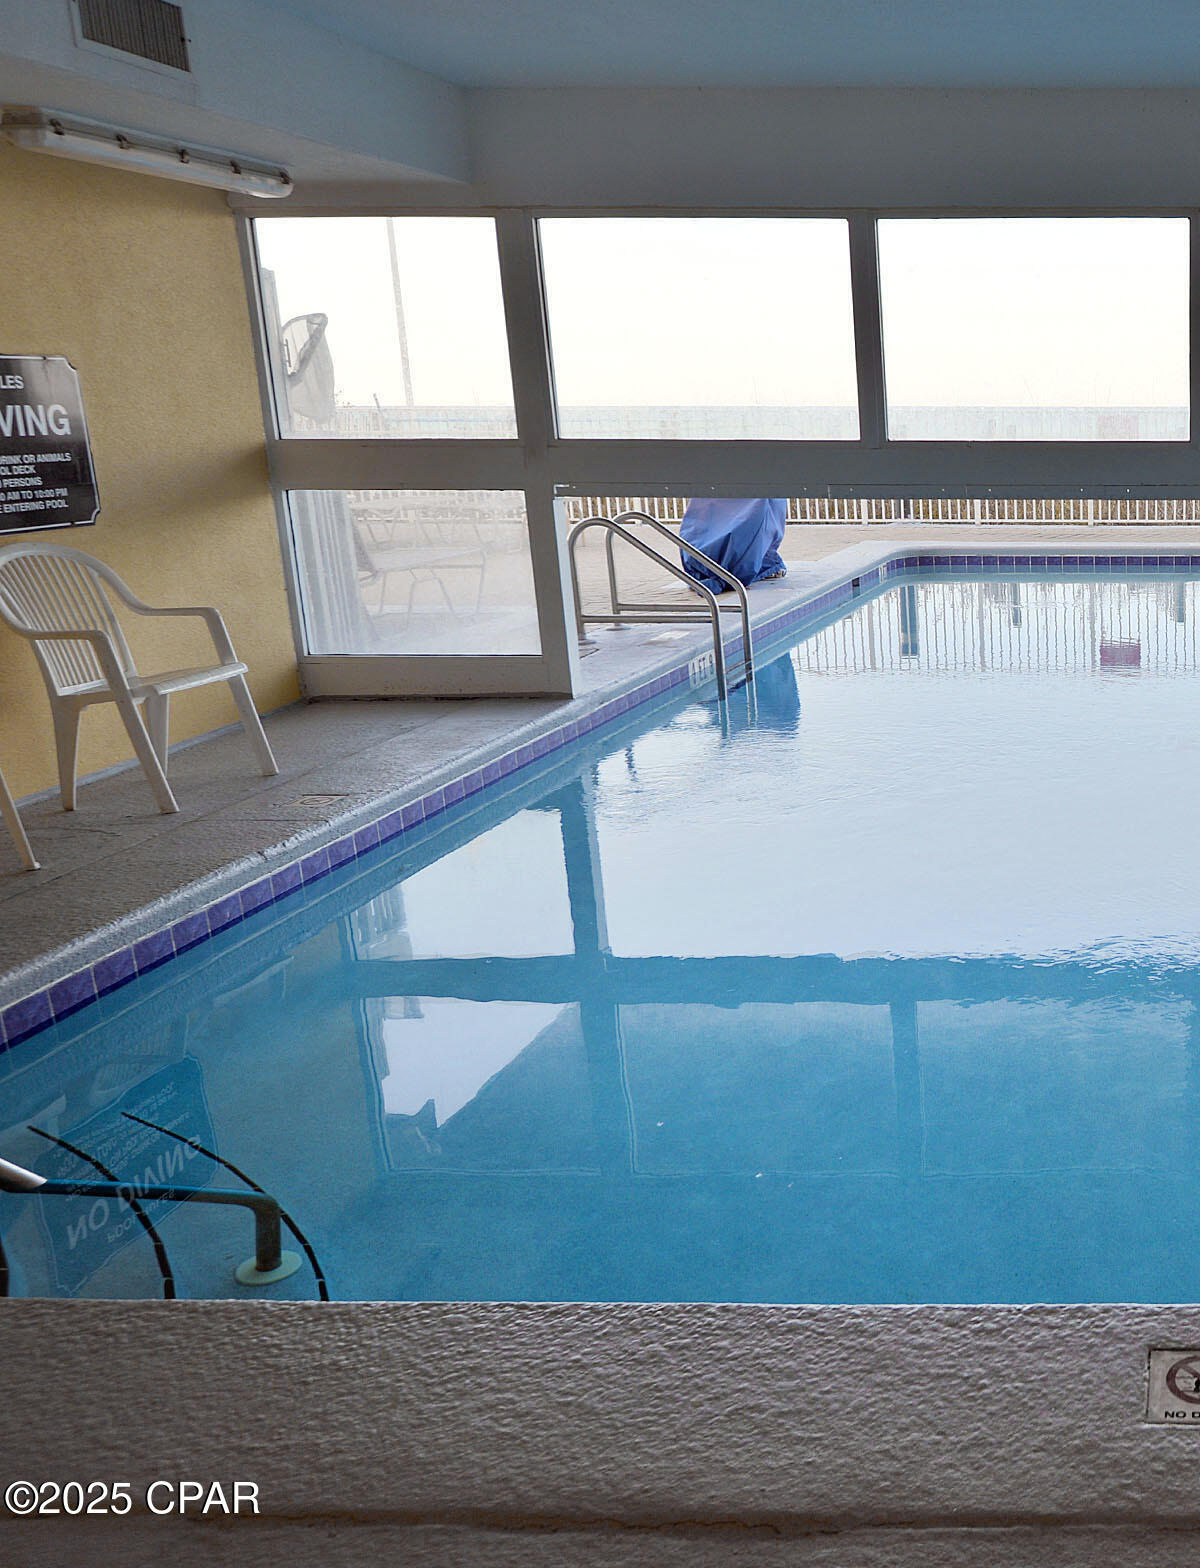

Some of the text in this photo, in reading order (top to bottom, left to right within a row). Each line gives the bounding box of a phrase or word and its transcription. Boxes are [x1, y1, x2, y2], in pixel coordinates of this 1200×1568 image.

[0, 375, 24, 389] LES
[0, 452, 72, 465] RINK OR ANIMALS
[12, 465, 37, 475] DECK
[3, 476, 43, 488] PERSONS
[7, 491, 20, 501] AM
[20, 490, 33, 500] TO
[34, 489, 55, 499] 10:00
[55, 487, 68, 497] PM
[3, 500, 45, 513] ENTERING
[45, 499, 69, 509] POOL
[1164, 1411, 1187, 1419] NO
